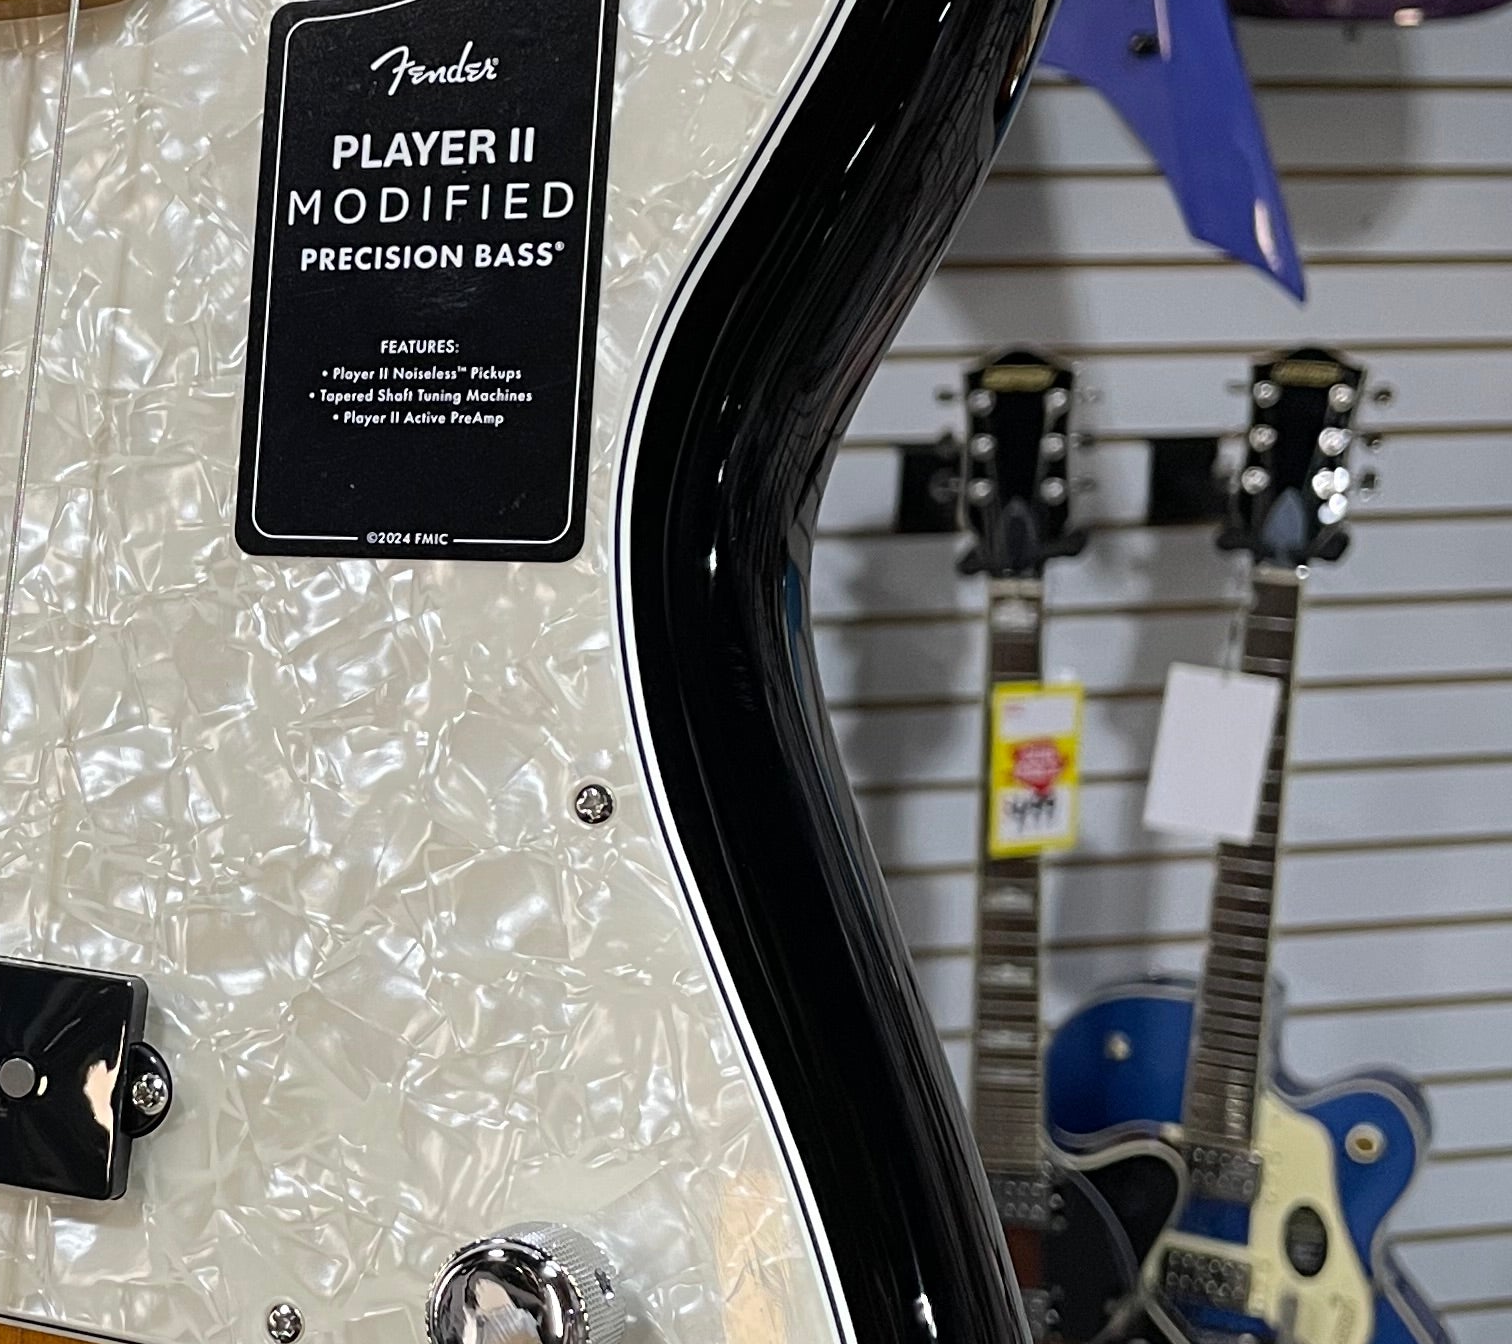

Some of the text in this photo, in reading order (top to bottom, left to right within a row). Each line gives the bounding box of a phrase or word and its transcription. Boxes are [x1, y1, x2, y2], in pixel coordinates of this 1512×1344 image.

[333, 127, 534, 169] PLAYER II
[288, 182, 573, 225] MODIFIED
[301, 245, 463, 271] PRECISION
[380, 340, 460, 354] FEATURES:
[333, 367, 375, 383] Player
[379, 367, 388, 380] II
[471, 366, 522, 383] Pickups
[320, 388, 533, 406] Tapered Shaft Tuning Machines
[344, 410, 504, 428] Player II Active PreAmp
[367, 531, 449, 546] ©2024 FMIC
